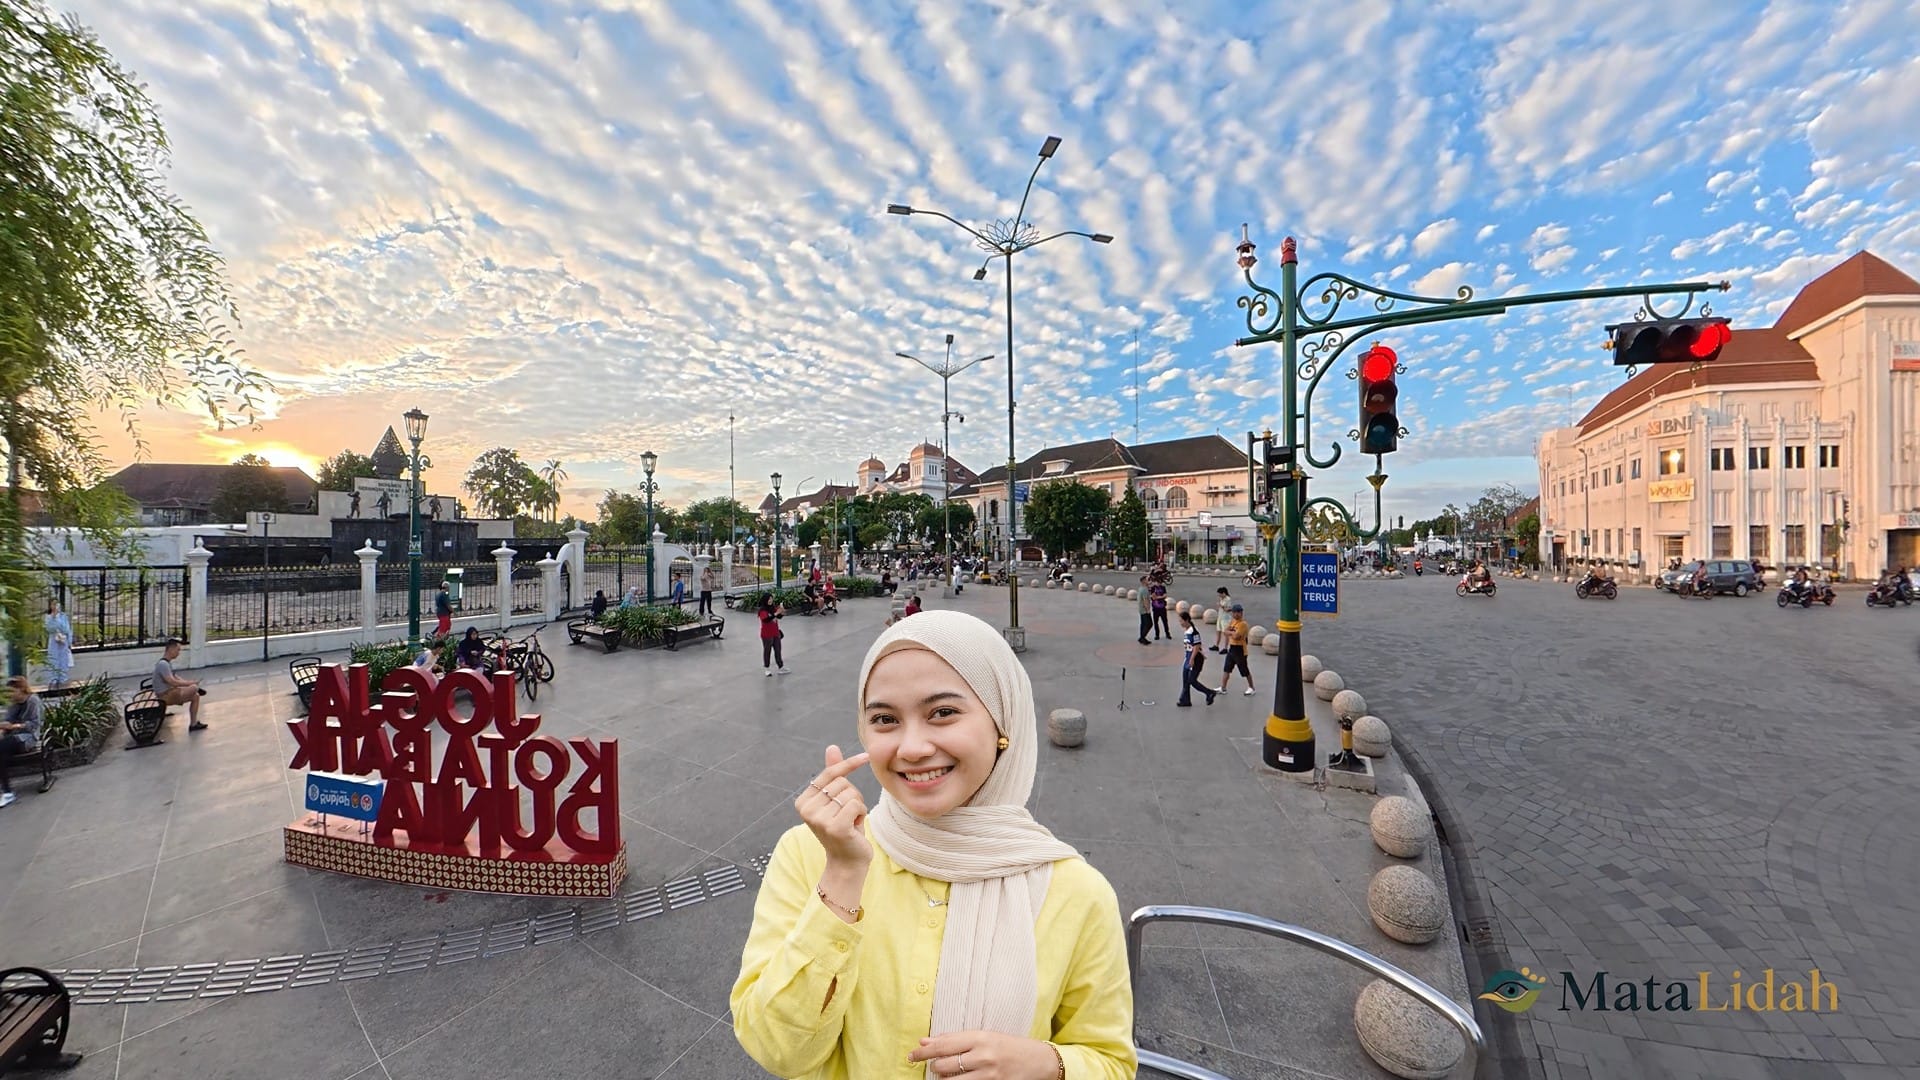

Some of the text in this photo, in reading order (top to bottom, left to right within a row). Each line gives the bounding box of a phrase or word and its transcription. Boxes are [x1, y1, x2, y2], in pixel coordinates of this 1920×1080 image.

[1662, 415, 1692, 434] BNI
[1156, 478, 1197, 487] INDONESIA
[1302, 564, 1336, 574] KE KIRI
[1303, 578, 1336, 588] JALAN
[1303, 592, 1336, 602] TERUS
